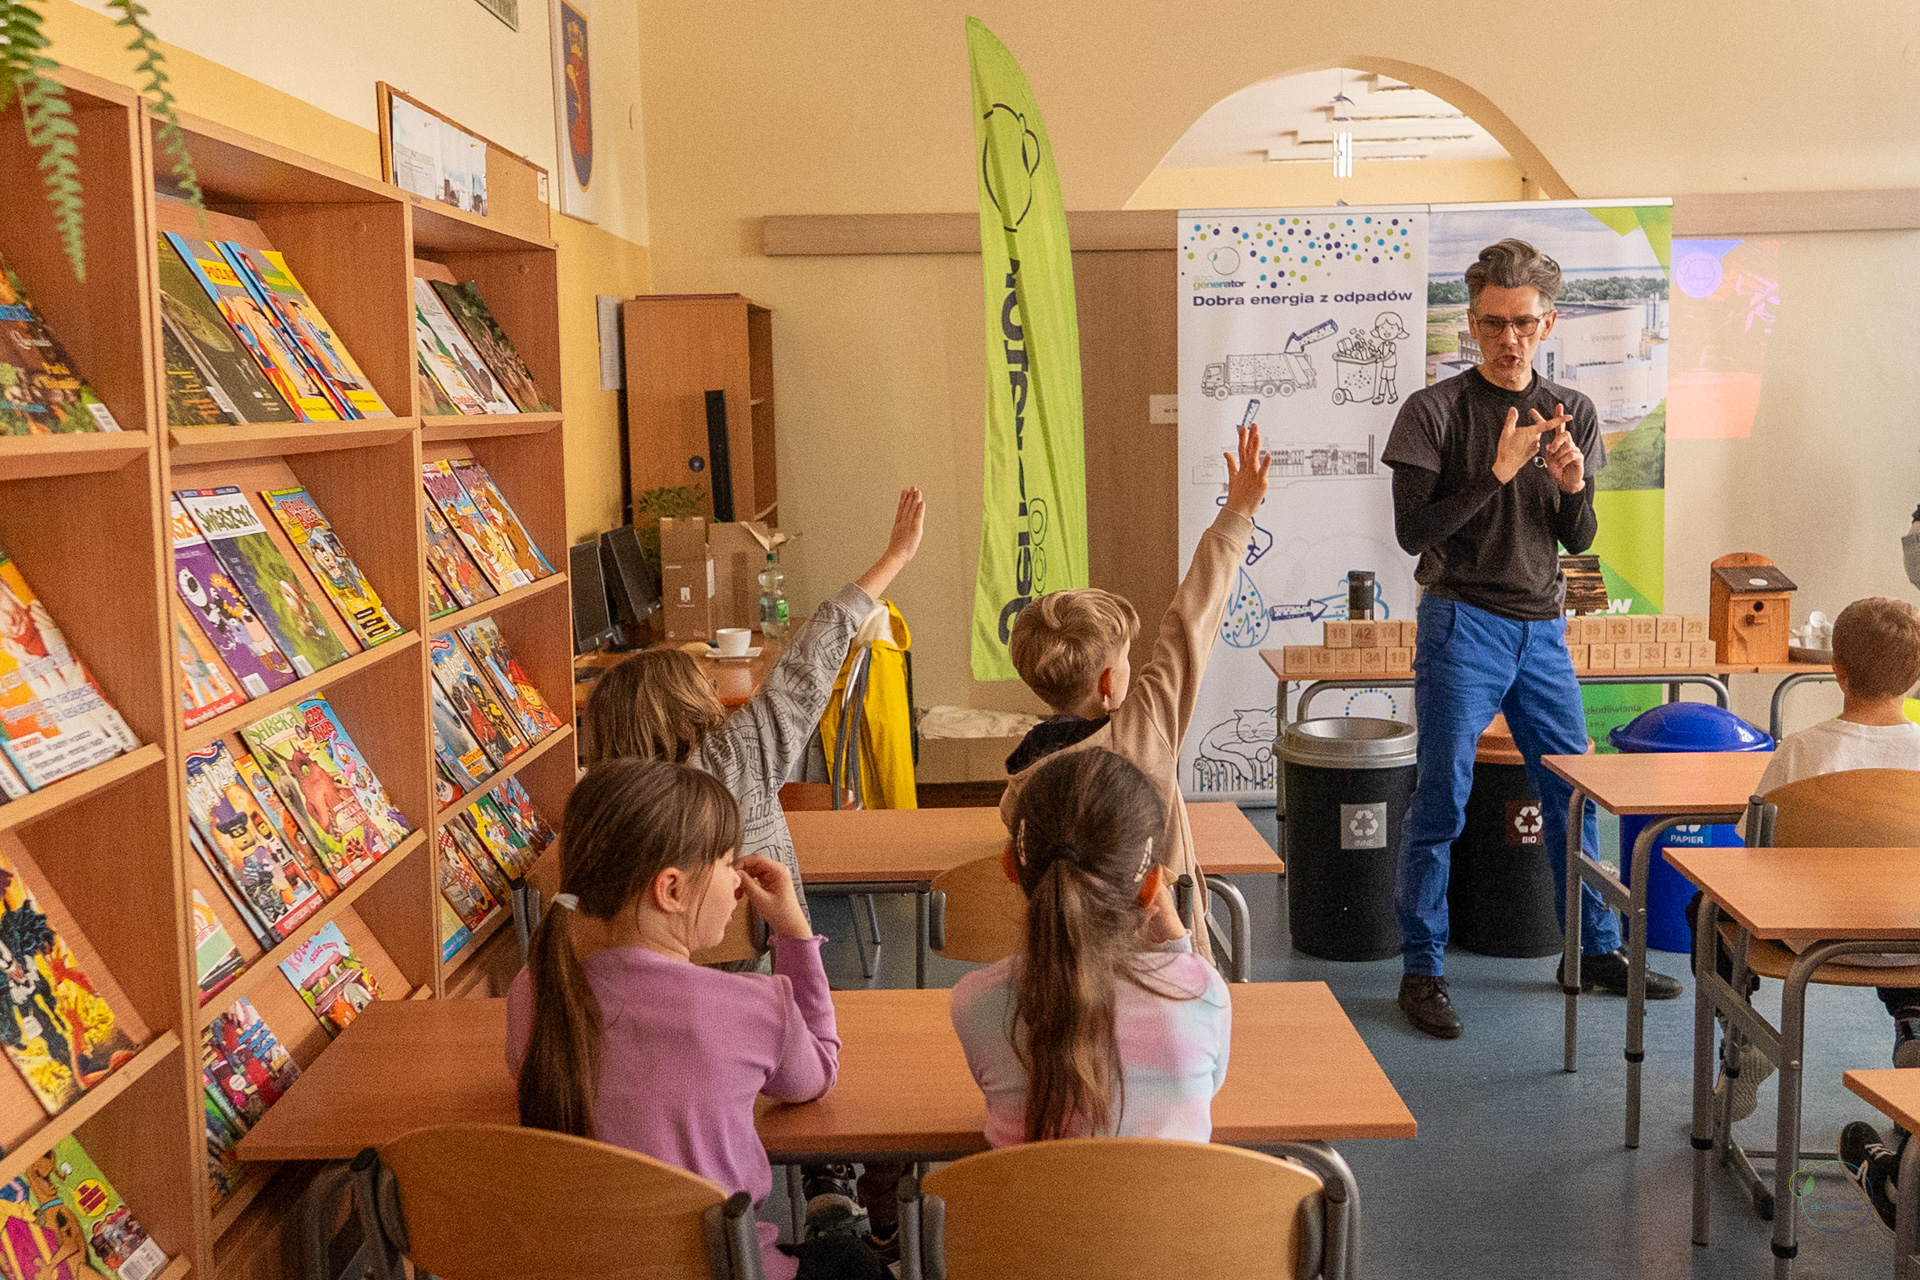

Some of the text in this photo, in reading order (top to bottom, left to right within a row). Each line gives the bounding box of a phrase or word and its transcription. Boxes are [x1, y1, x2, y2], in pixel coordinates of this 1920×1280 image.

[1193, 279, 1246, 291] generator
[1192, 290, 1413, 307] Dobra energia z odpadów
[1355, 627, 1371, 640] 42
[1610, 623, 1626, 635] 13
[1636, 622, 1652, 634] 12
[1365, 652, 1381, 664] 34
[1623, 648, 1631, 660] 5
[1673, 647, 1682, 658] 3
[1699, 647, 1707, 658] 2
[1521, 835, 1537, 844] BIO
[1670, 834, 1704, 844] PAPIER
